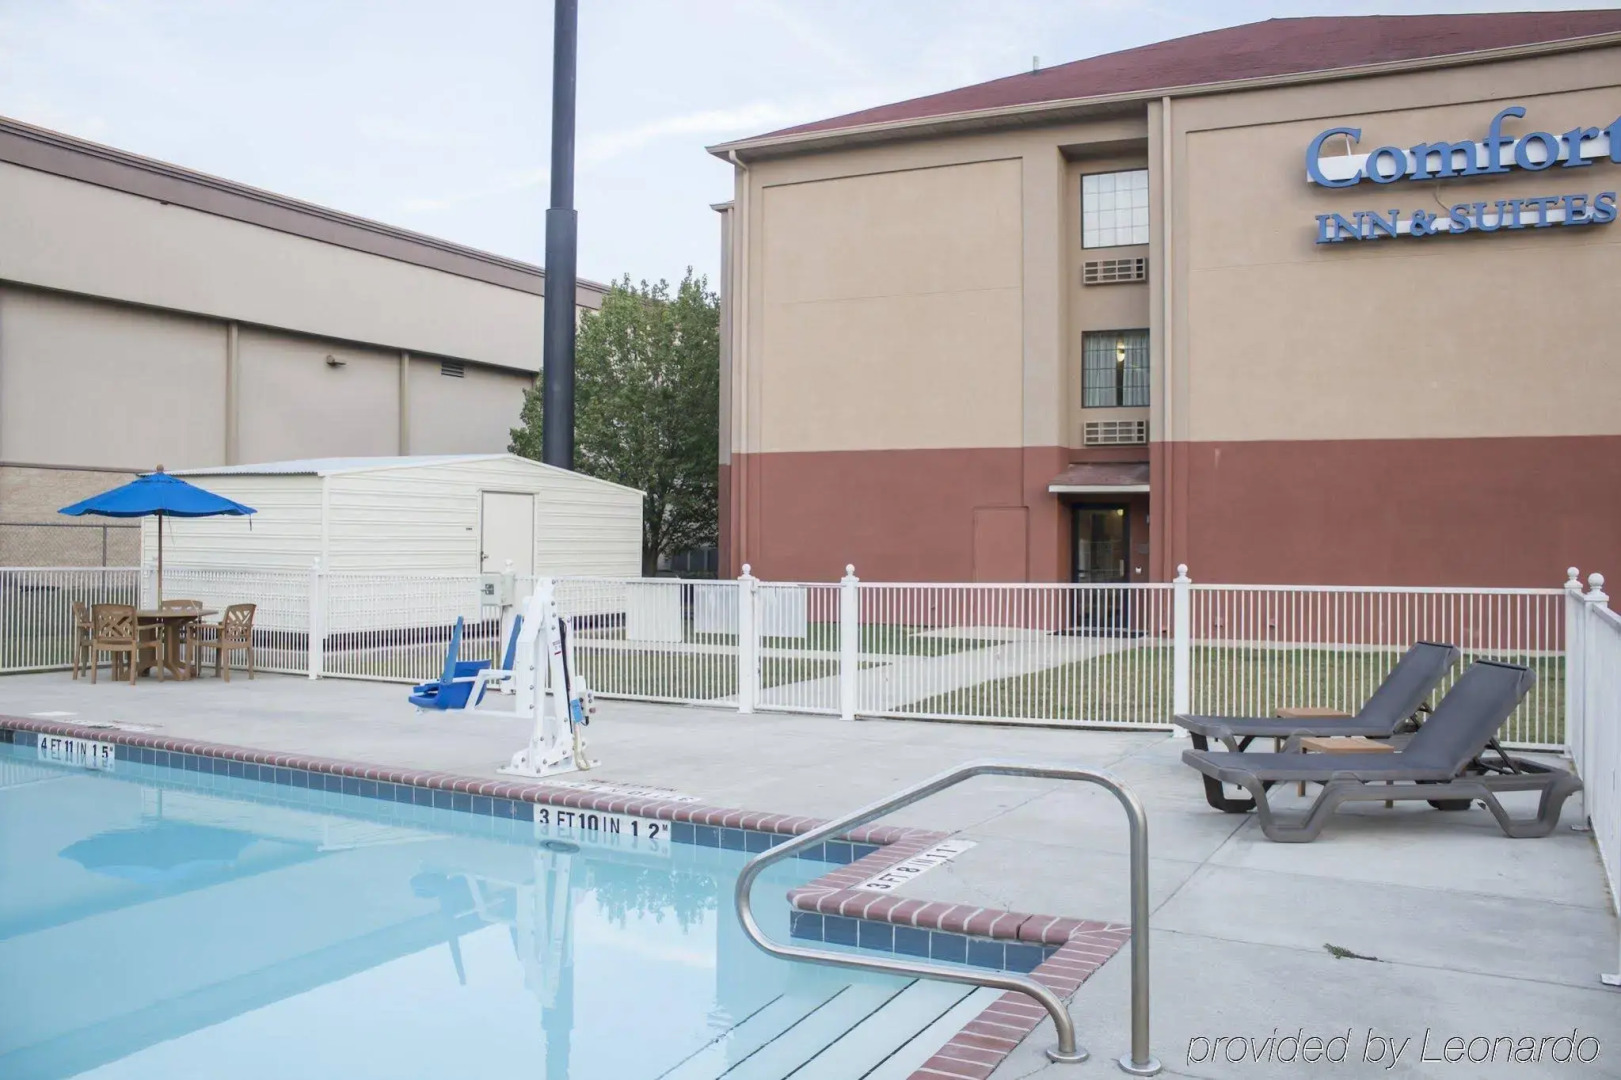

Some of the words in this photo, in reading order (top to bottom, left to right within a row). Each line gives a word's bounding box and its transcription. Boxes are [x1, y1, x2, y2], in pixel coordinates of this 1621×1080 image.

[1306, 106, 1621, 188] Comfort
[1315, 209, 1400, 244] INN
[1409, 209, 1439, 237] &
[1449, 191, 1618, 235] SUITES
[41, 737, 47, 749] 4
[51, 739, 61, 751] FT
[65, 740, 73, 752] 11
[77, 742, 86, 755] IN
[539, 808, 549, 824] 3
[557, 810, 575, 828] FT
[578, 813, 599, 831] 10
[603, 816, 620, 834] IN
